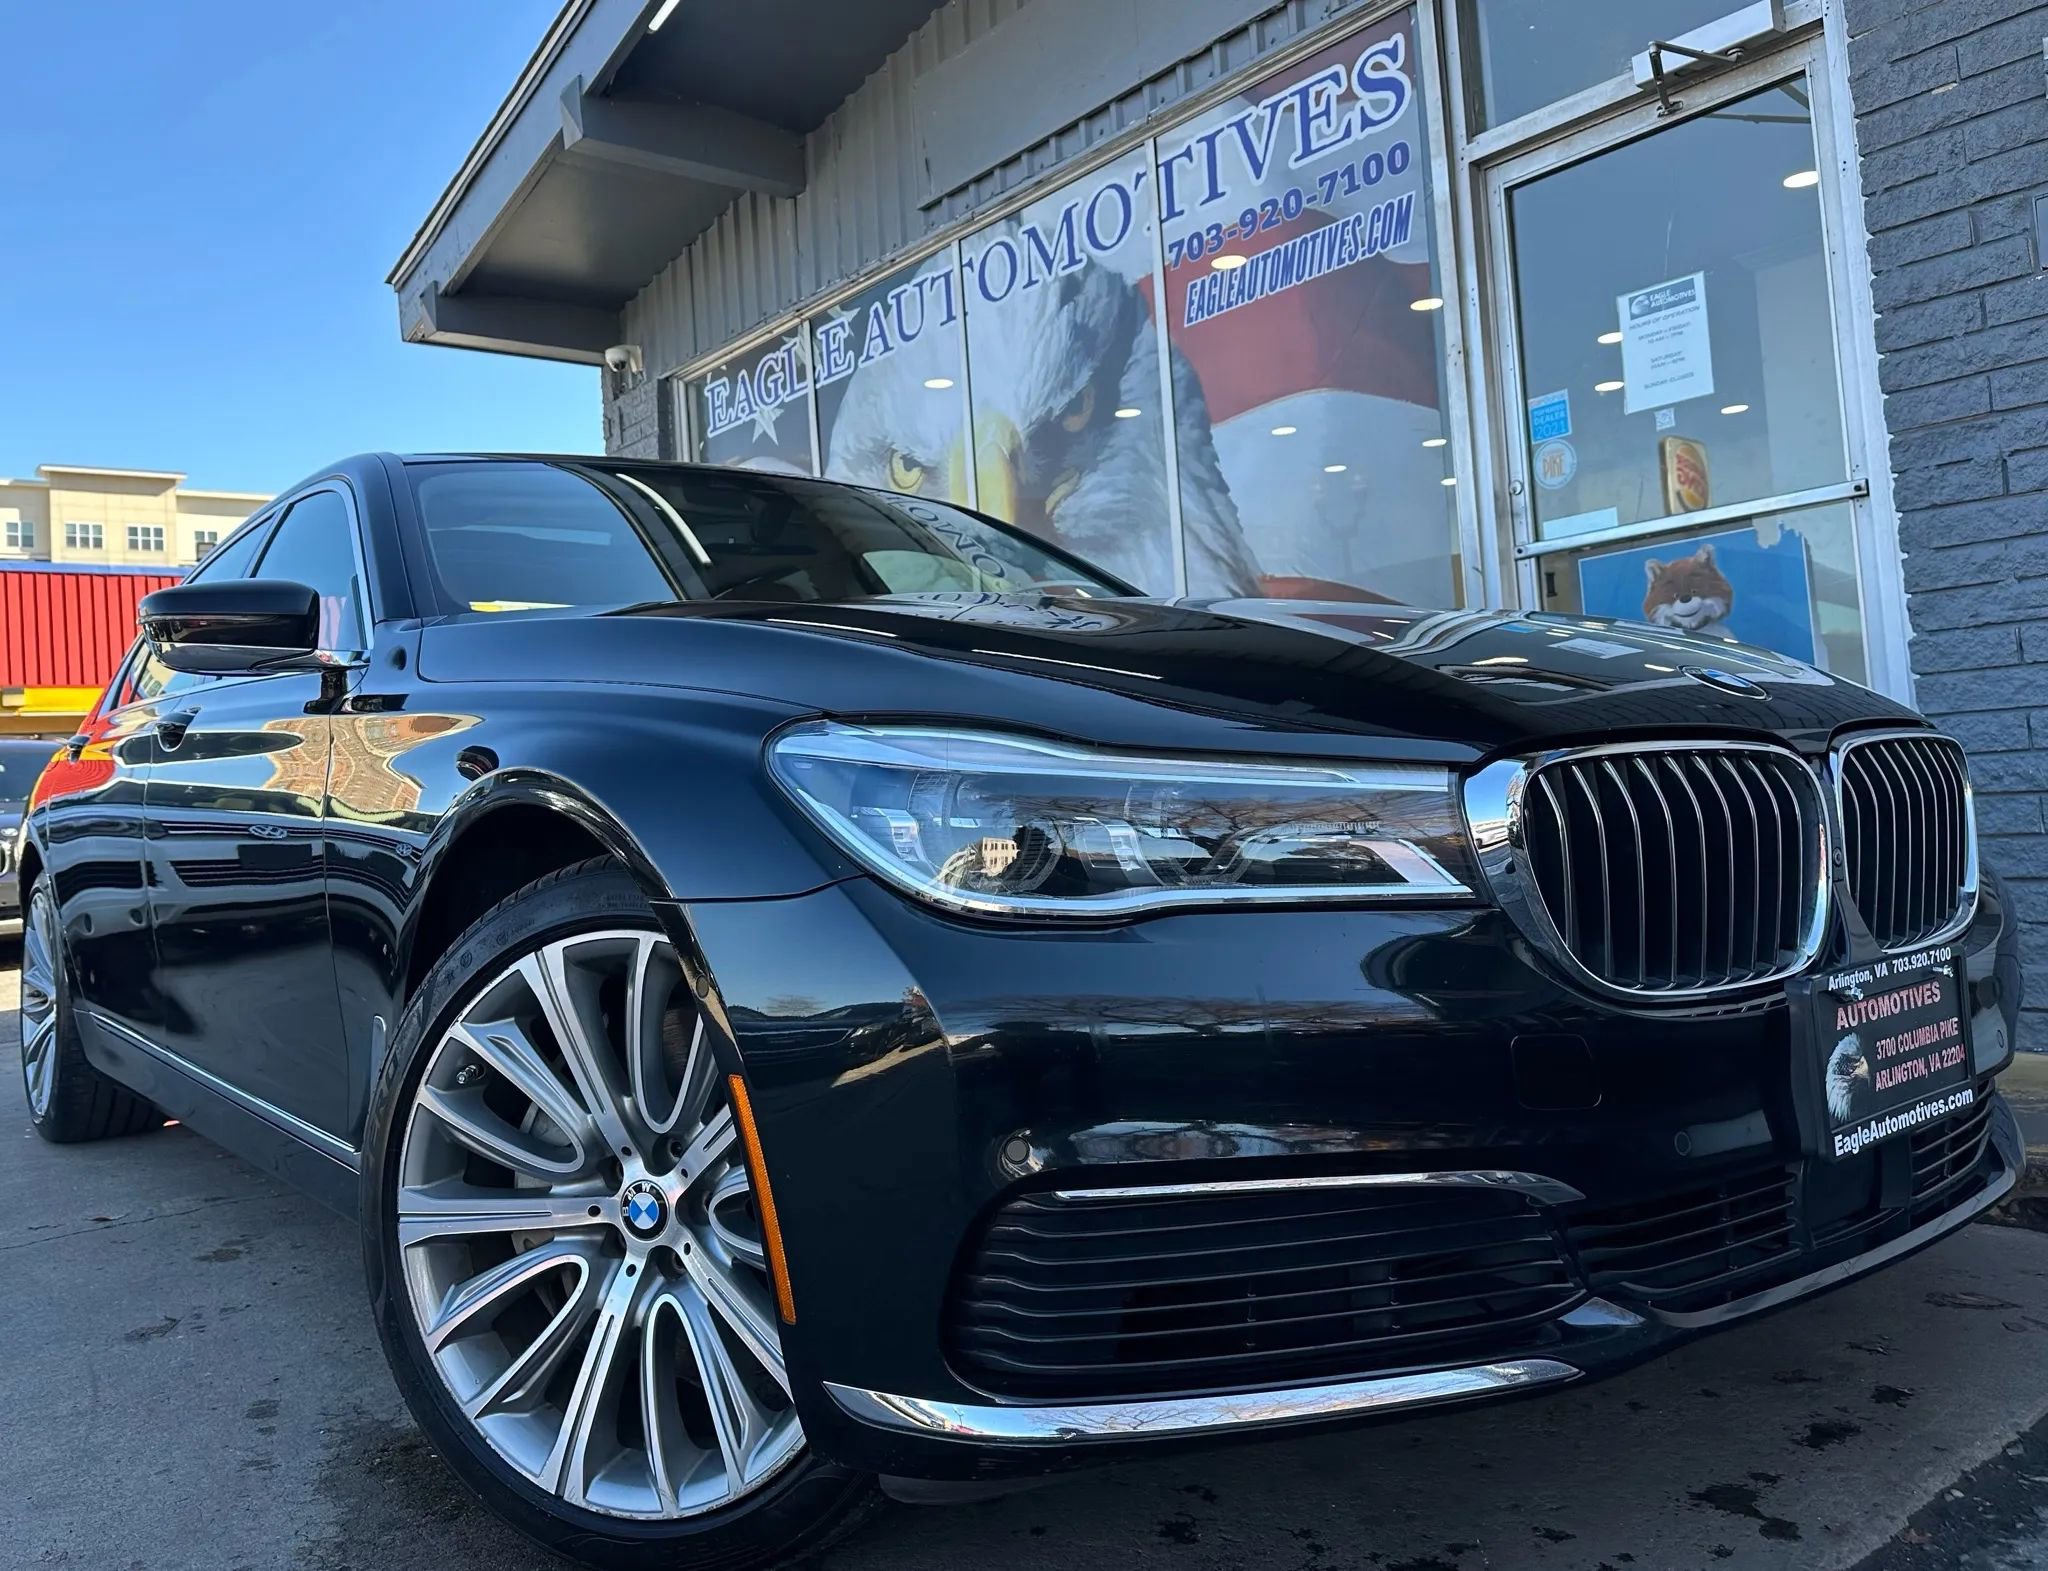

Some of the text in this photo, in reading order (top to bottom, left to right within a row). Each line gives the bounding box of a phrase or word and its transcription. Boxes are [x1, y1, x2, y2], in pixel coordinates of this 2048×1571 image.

[1168, 141, 1410, 270] 703-920-7100
[705, 33, 1411, 437] EAGLE AUTOMOTIVES
[1185, 191, 1416, 327] EAGLEAUTOMOTIVES.COM
[1650, 289, 1671, 301] EAGLE
[1651, 289, 1696, 308] AUTOMOTIVES
[1534, 411, 1566, 426] DEALER
[1535, 420, 1567, 440] 2021
[1828, 946, 1952, 991] Arlington, VA 703.920.7100
[1836, 981, 1941, 1030] AUTOMOTIVES
[1875, 1017, 1959, 1060] 3700 COLUMBIA PIKE
[1875, 1043, 1966, 1091] ARLINGTON, VA 22204
[1834, 1088, 1973, 1156] EagleAutomotives.com
[622, 1182, 652, 1217] BMW
